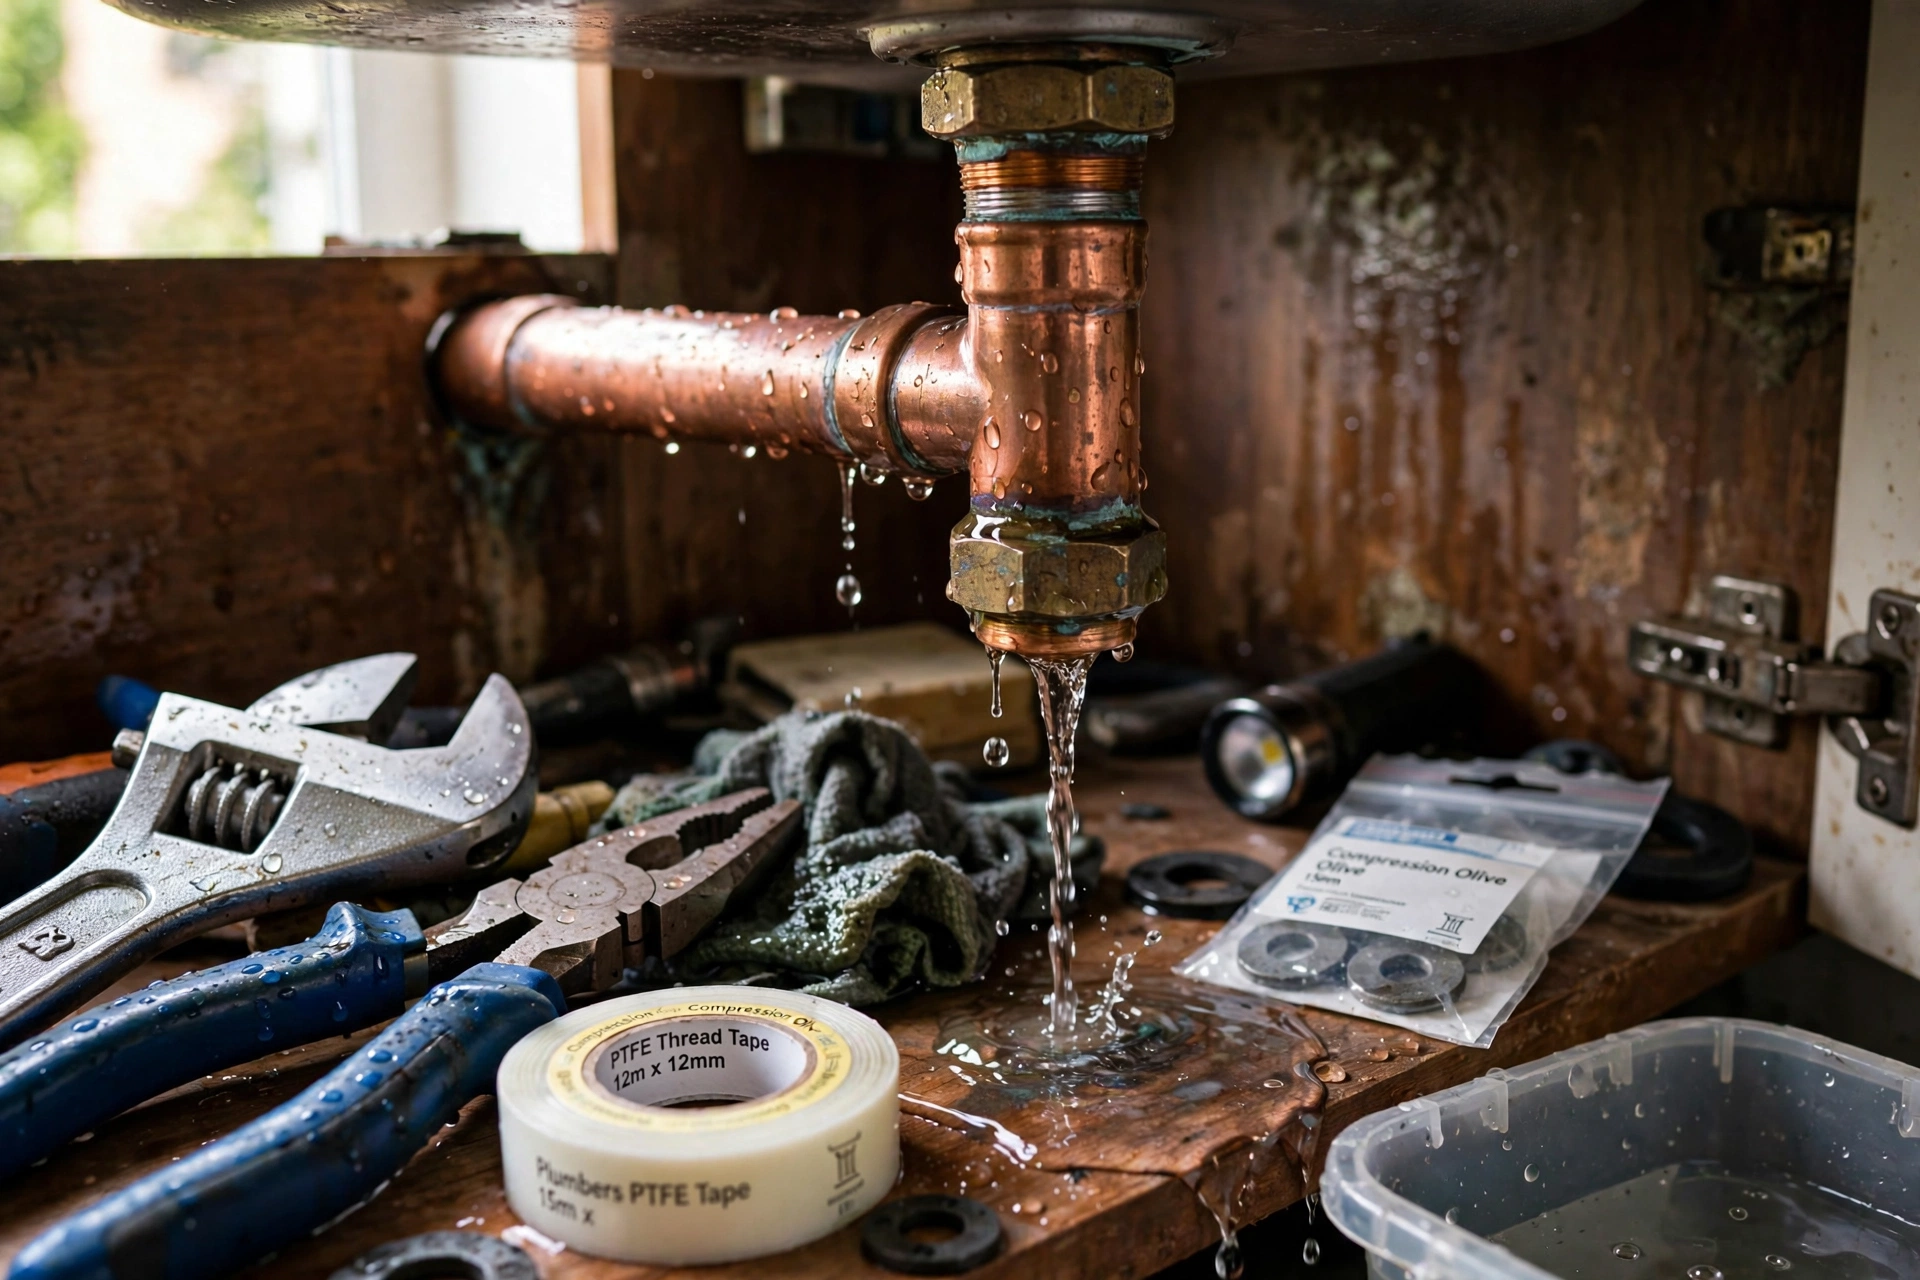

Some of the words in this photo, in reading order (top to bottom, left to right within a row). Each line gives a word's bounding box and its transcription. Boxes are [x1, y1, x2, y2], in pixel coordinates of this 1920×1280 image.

[1316, 859, 1366, 877] Olive
[1327, 846, 1450, 877] Compression
[1454, 866, 1508, 887] Olive
[688, 1004, 792, 1020] Compression
[610, 1037, 653, 1070] PTFE
[656, 1028, 723, 1051] Thread
[728, 1028, 770, 1052] Tape
[612, 1066, 646, 1092] 12m
[651, 1062, 662, 1077] x
[667, 1053, 726, 1073] 12mm
[535, 1156, 623, 1204] Plumbers
[629, 1181, 691, 1207] PTFE
[695, 1181, 751, 1209] Tape
[582, 1209, 594, 1225] x
